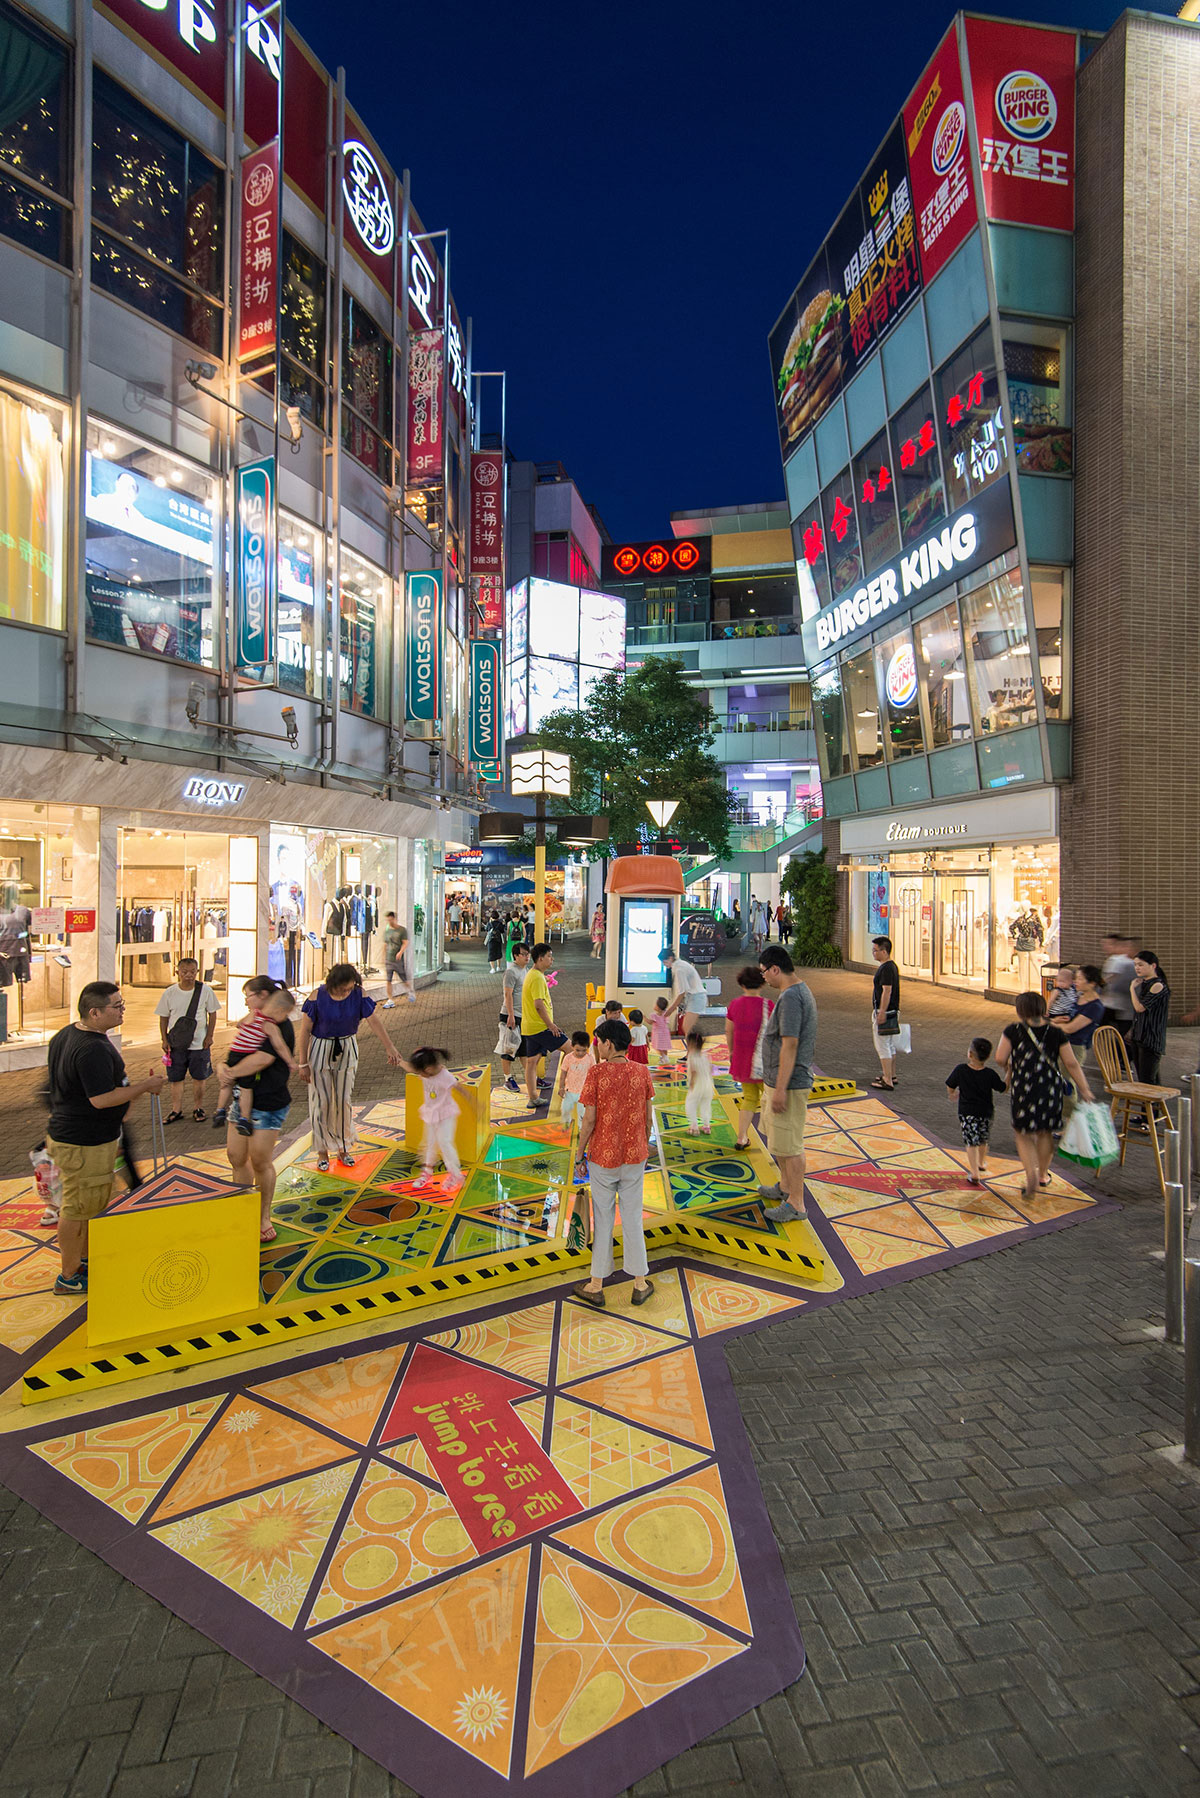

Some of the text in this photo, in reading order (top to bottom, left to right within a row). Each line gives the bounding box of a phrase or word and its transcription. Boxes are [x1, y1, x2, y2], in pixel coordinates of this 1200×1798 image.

[1004, 89, 1047, 105] BURGER
[1005, 101, 1050, 122] KING
[936, 107, 960, 158] BURGER
[938, 114, 961, 168] KING
[981, 138, 1068, 186] 汉堡王
[920, 155, 967, 238] 汉堡王
[922, 185, 969, 252] TASTE IS KING
[252, 209, 272, 304] 豆捞坊
[415, 455, 434, 469] 3F
[481, 492, 497, 546] 豆捞坊
[247, 495, 262, 640] watsons
[816, 513, 977, 651] BURGER KING
[485, 609, 498, 620] 3F
[416, 594, 431, 702] watsons
[479, 659, 491, 744] watsons
[186, 780, 244, 801] BONI
[886, 822, 967, 841] Etam BOUTIQUE
[828, 1170, 898, 1180] dancing
[412, 1401, 517, 1537] jump to see
[452, 1391, 564, 1520] 跳上去看看
